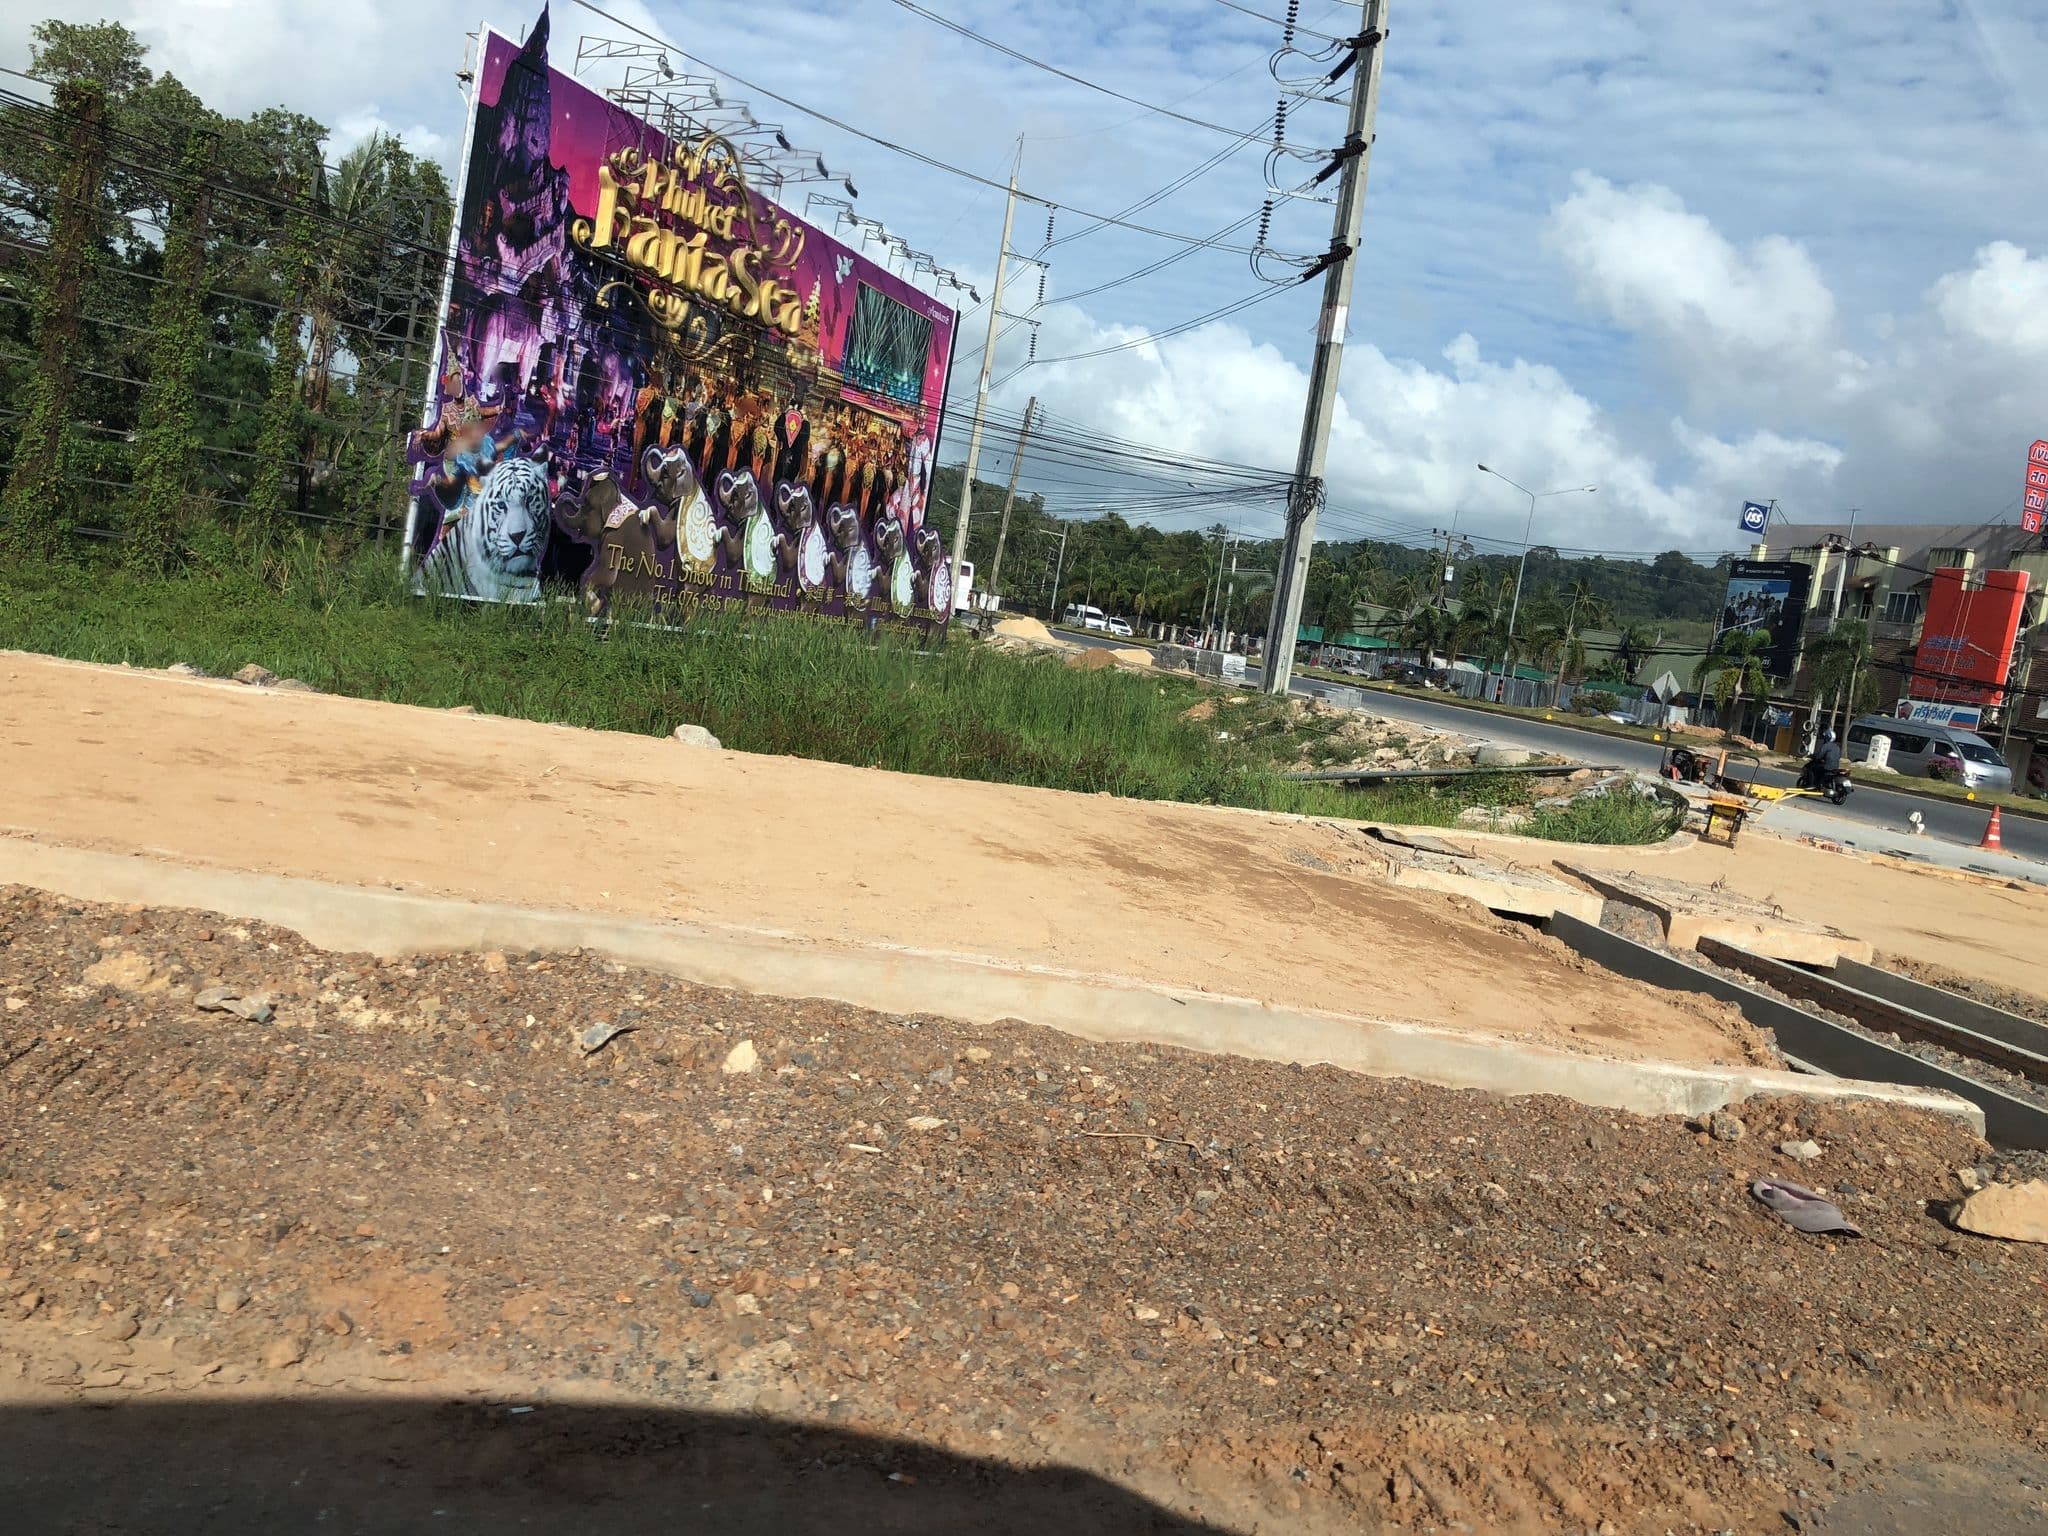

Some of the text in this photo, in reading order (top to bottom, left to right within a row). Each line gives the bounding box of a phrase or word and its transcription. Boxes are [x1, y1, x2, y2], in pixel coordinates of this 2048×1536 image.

[637, 156, 738, 241] Phuket
[607, 544, 793, 598] The No.1 Show in Thailand!
[654, 585, 676, 605] Tel:
[678, 590, 699, 609] 076
